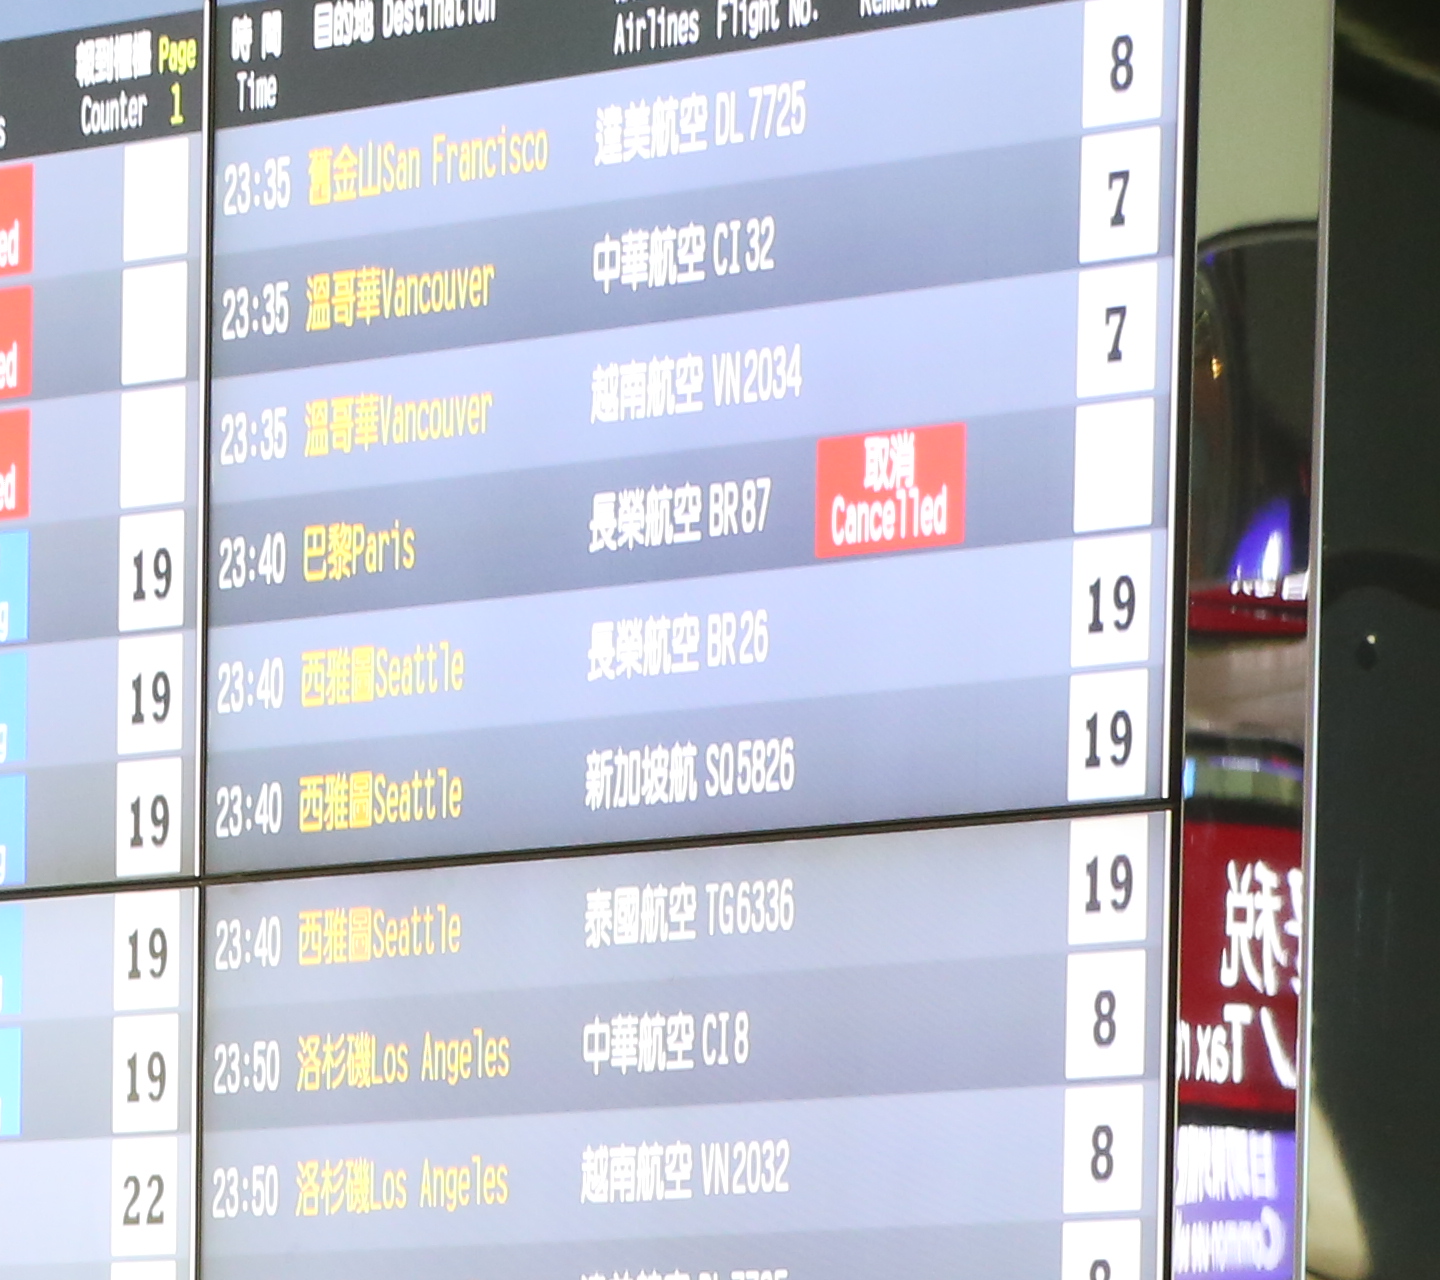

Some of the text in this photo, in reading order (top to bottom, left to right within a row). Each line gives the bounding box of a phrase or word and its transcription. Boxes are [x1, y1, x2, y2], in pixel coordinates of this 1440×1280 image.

[158, 34, 198, 75] Page
[613, 8, 700, 57] Airlines
[716, 0, 781, 40] Flight
[80, 90, 149, 136] Counter
[169, 81, 184, 126] 1
[235, 71, 278, 113] Time
[223, 155, 291, 215] 23:35
[432, 124, 548, 185] Francisco
[594, 91, 708, 166] 達美航空
[1110, 34, 1134, 92] 8
[222, 281, 289, 340] 23:35
[593, 222, 706, 293] 中華航空
[1109, 170, 1130, 227] 7
[864, 431, 916, 491] 取消
[218, 531, 286, 589] 23:40
[589, 482, 702, 552] 長榮航空
[831, 484, 948, 545] Cancelled
[133, 547, 172, 601] 19
[217, 656, 284, 713] 23:40
[587, 612, 700, 681] 長榮航空
[1088, 575, 1136, 633] 19
[213, 1040, 280, 1094] 23:50
[421, 1027, 510, 1085] Angeles
[583, 1010, 694, 1075] 中華航空
[1093, 990, 1116, 1047] 8
